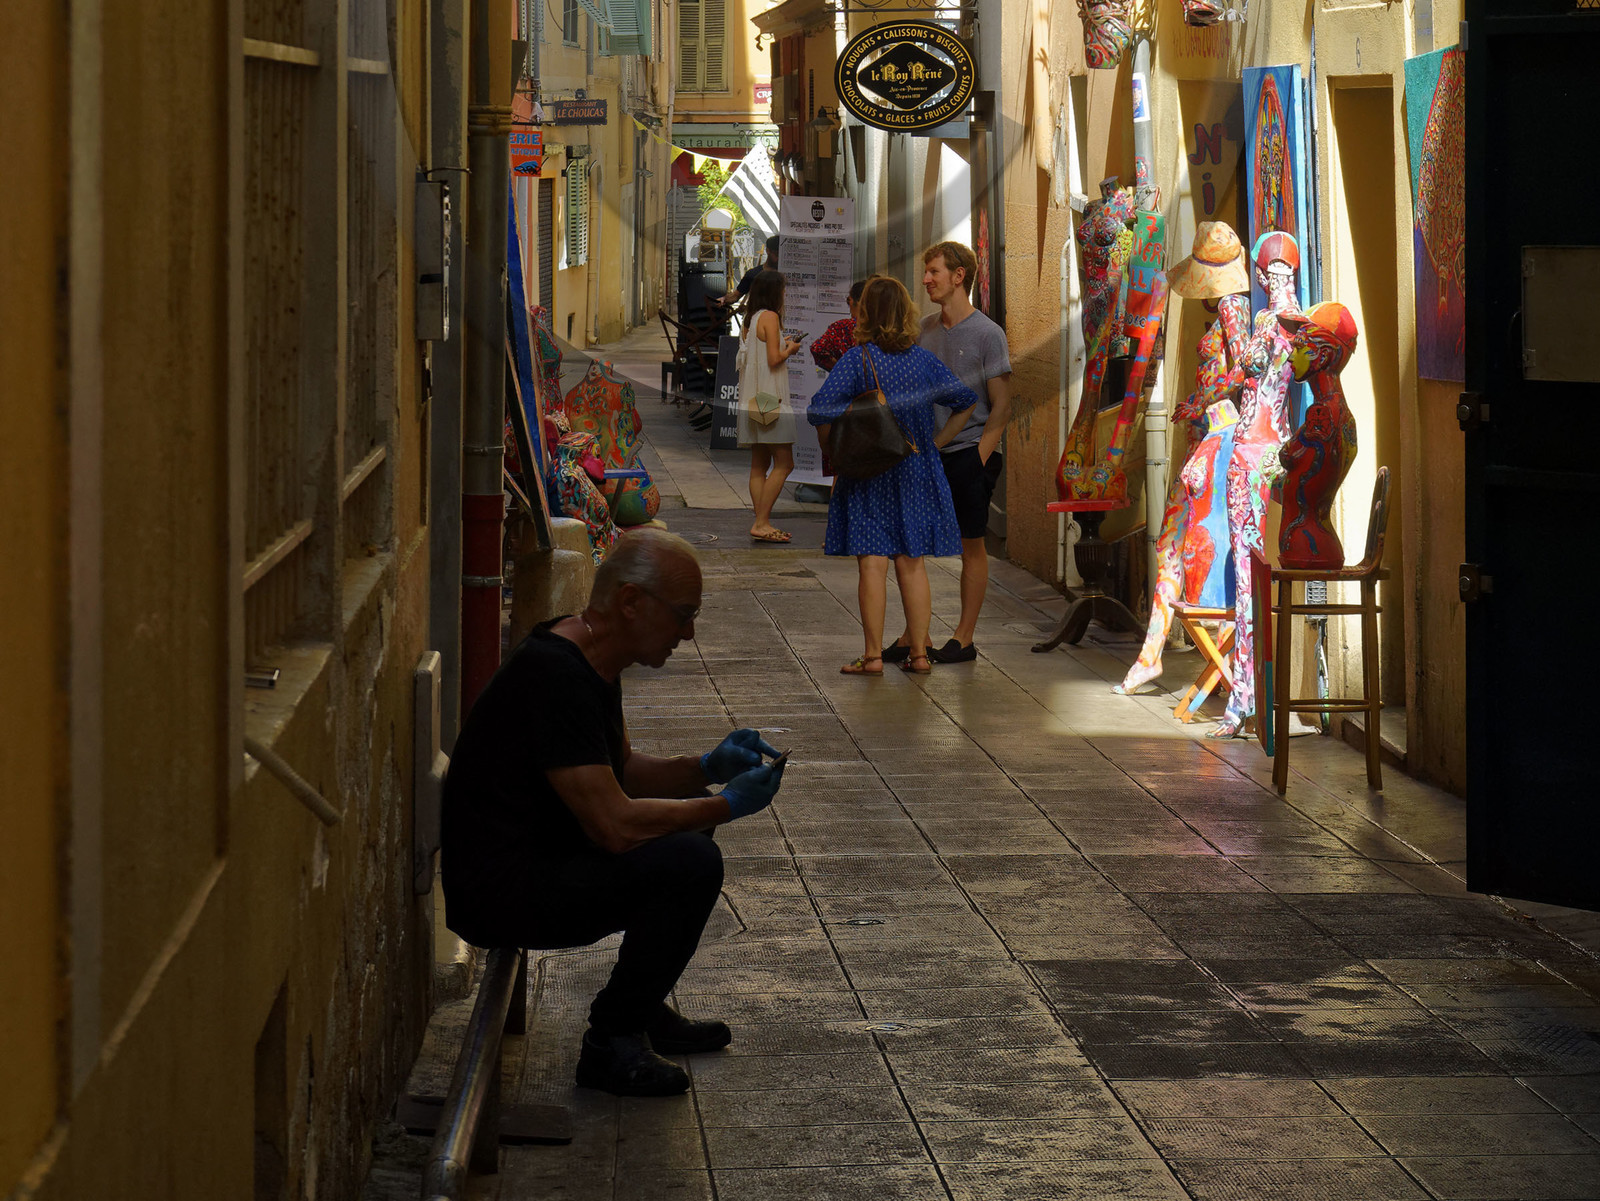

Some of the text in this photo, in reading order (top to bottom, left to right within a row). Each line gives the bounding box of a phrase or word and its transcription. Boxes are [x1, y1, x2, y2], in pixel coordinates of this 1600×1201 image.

[883, 28, 928, 40] CALISSONS
[845, 37, 876, 69] NOUGATS
[936, 35, 967, 64] BISCUITS
[871, 70, 880, 81] le
[880, 62, 908, 84] Roy
[907, 61, 943, 81] René
[843, 79, 878, 118] CHOCOLATS
[924, 103, 951, 121] FRUITS
[949, 75, 971, 106] CONFITS
[557, 108, 604, 118] LE CHOUCAS
[885, 113, 915, 123] GLACES
[509, 132, 541, 145] ERIE
[1146, 215, 1159, 239] 7
